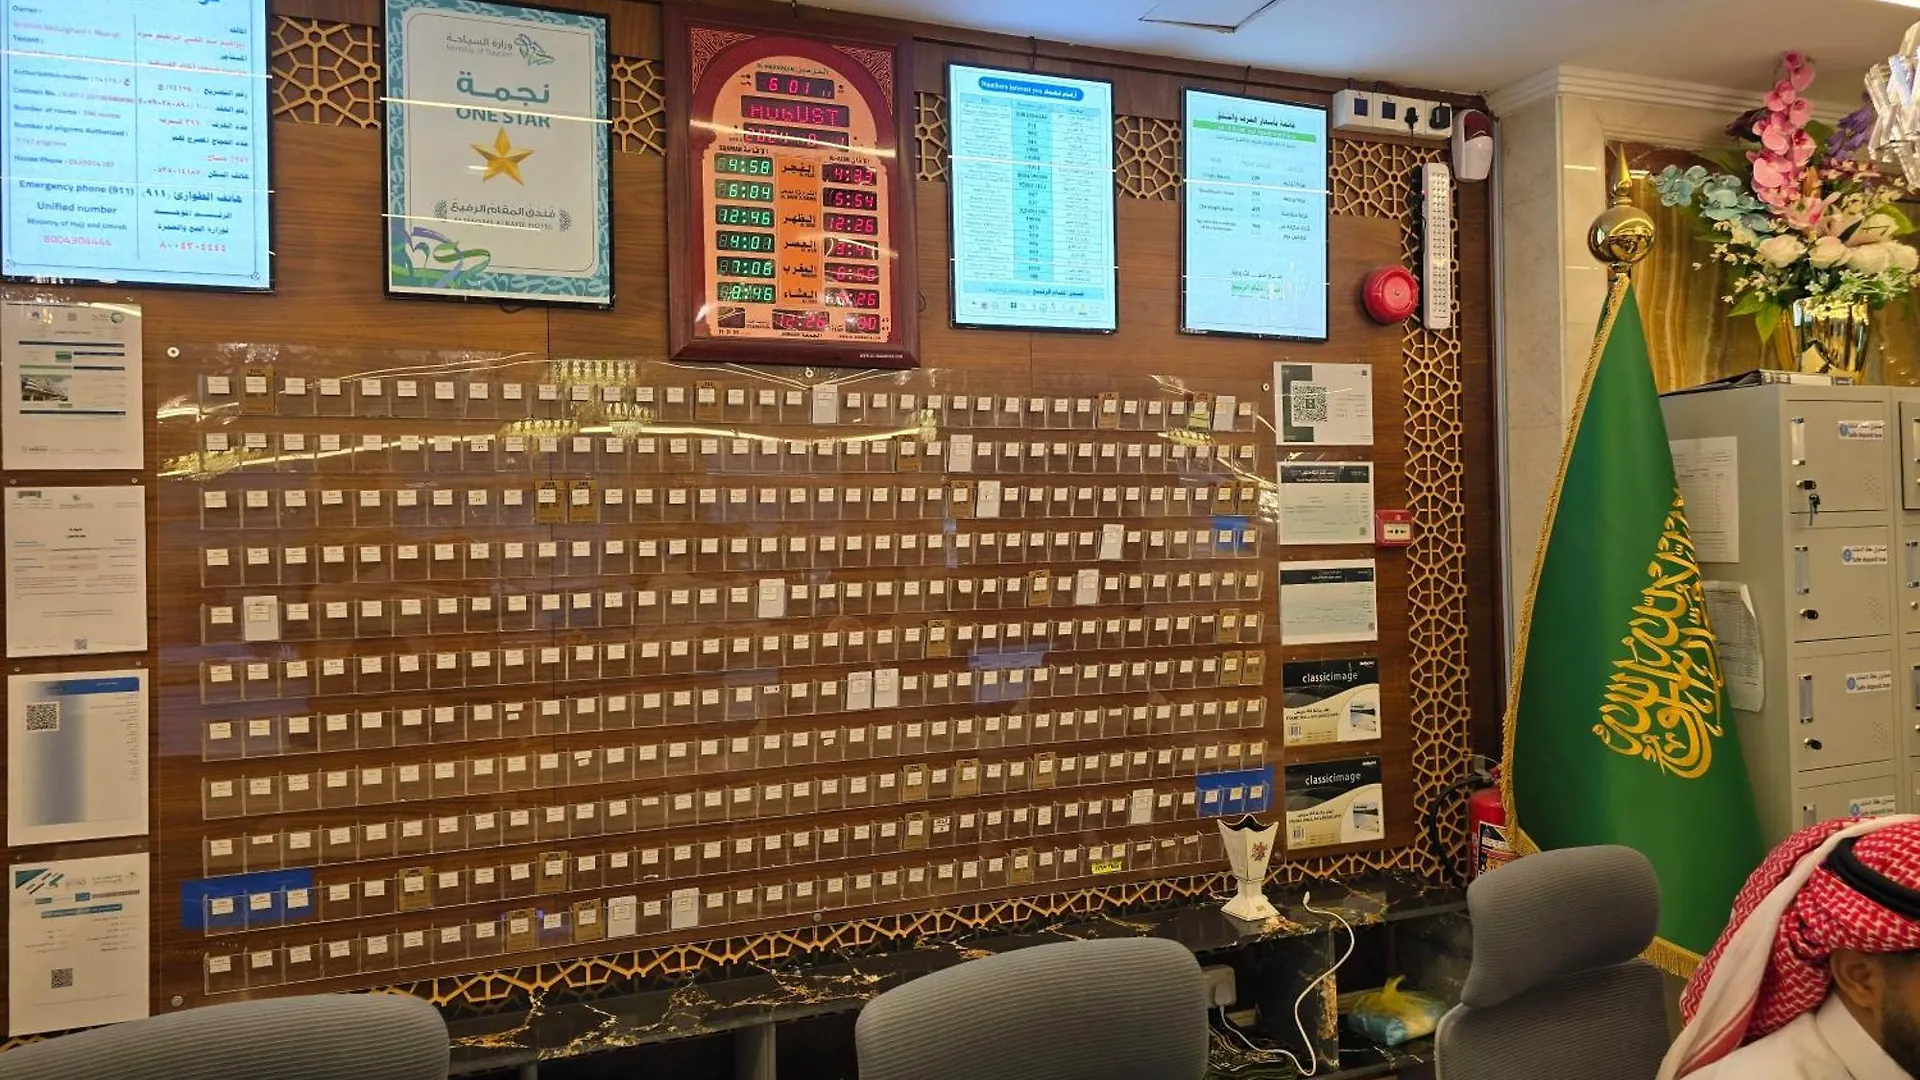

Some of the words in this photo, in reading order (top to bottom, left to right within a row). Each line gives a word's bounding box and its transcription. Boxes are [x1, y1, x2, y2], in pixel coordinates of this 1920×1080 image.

[446, 33, 490, 46] السياحة
[492, 38, 513, 51] وزارة
[456, 70, 550, 107] نجمة
[456, 107, 498, 123] ONE
[501, 110, 551, 128] STAR
[728, 159, 770, 175] 4:58
[781, 164, 814, 173] الفجر
[19, 180, 74, 192] Emergency
[76, 185, 106, 193] phone
[108, 186, 134, 196] (911)
[728, 184, 770, 201] 6:04
[450, 199, 486, 213] الرفيع
[835, 193, 874, 208] 5:54
[37, 202, 75, 212] Unified
[77, 205, 117, 214] number
[722, 208, 770, 225] 12:46
[783, 213, 815, 224] الظهر
[828, 218, 874, 234] 12:26
[730, 236, 772, 250] 4:01
[783, 240, 816, 250] العصر
[732, 261, 772, 276] 7:06
[783, 264, 816, 274] المغرب
[784, 287, 817, 298] العشاء
[1302, 672, 1359, 684] classicimage
[1305, 772, 1362, 785] classicimage
